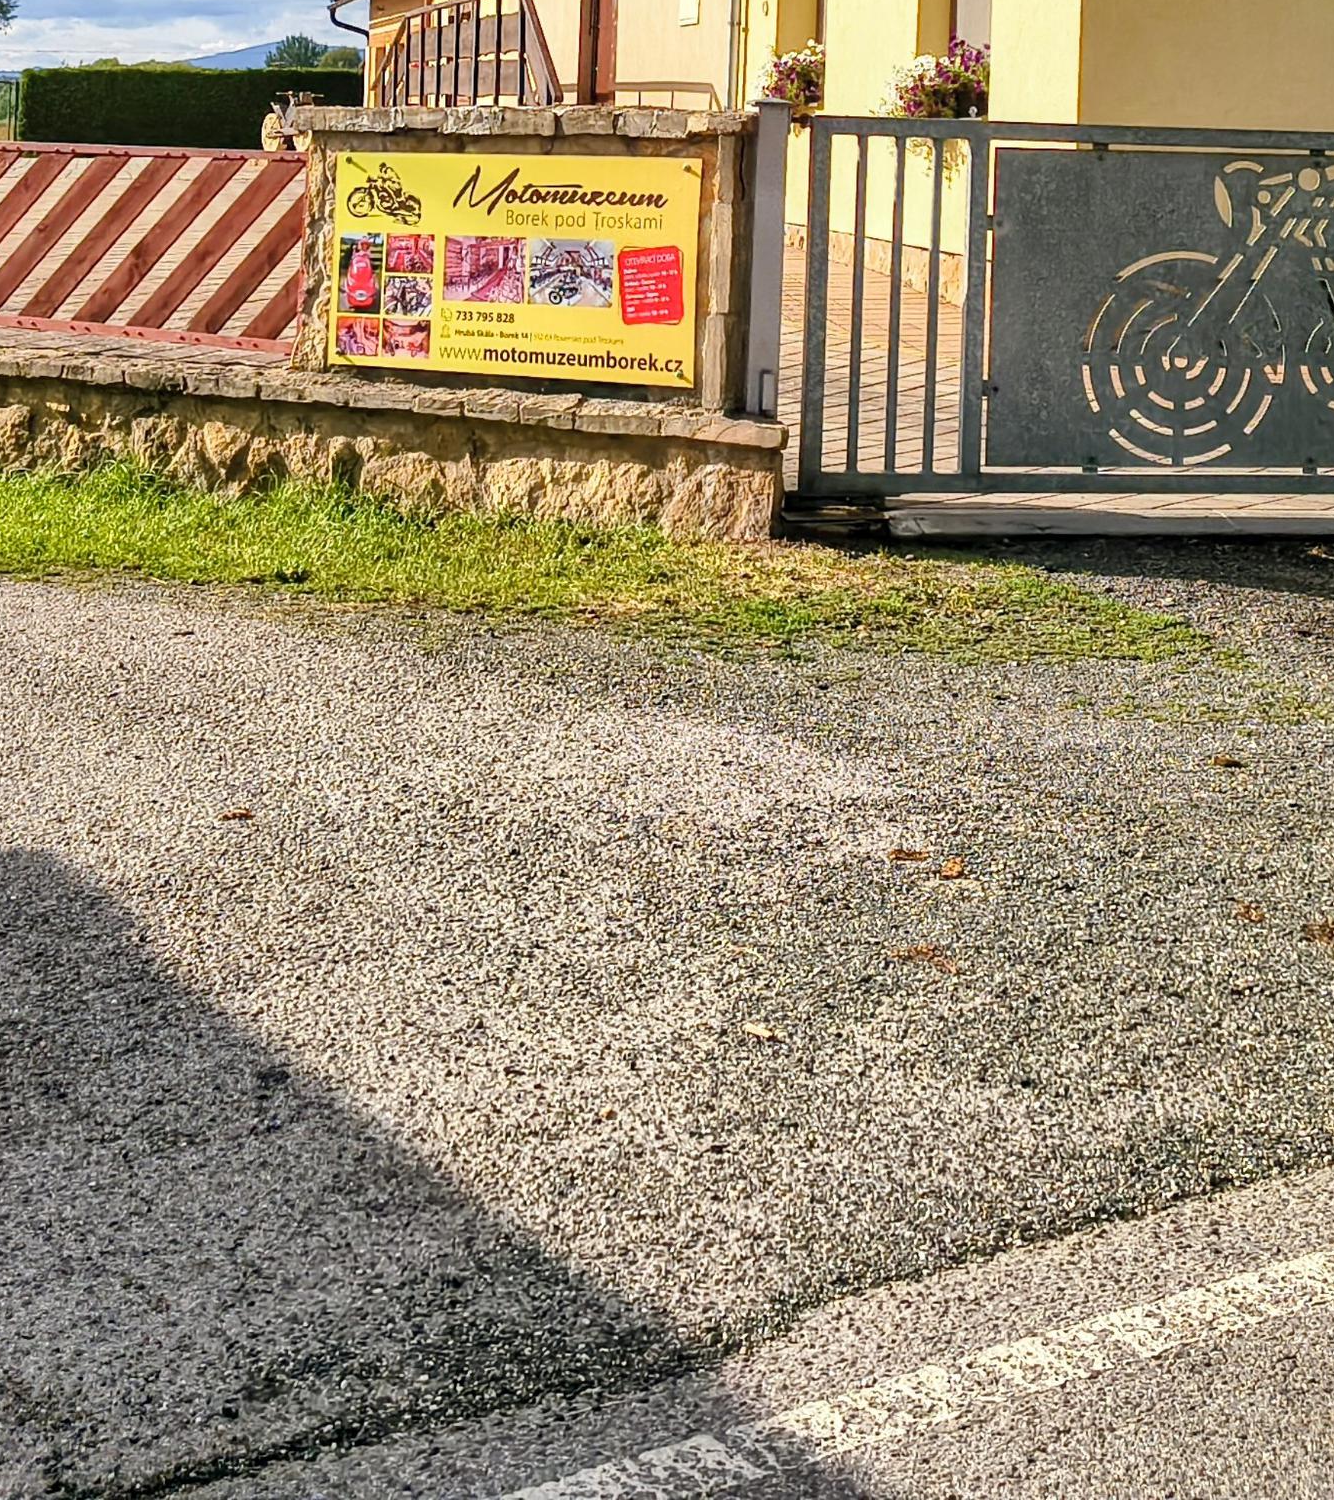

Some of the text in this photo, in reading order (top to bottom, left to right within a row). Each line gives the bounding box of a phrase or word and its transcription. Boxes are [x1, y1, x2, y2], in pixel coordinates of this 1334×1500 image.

[452, 165, 668, 216] Motomuzeum
[506, 209, 664, 230] Borek pod Troskami
[456, 311, 515, 324] 733 795 828
[439, 346, 683, 373] www.motomuzeumborek.cz
